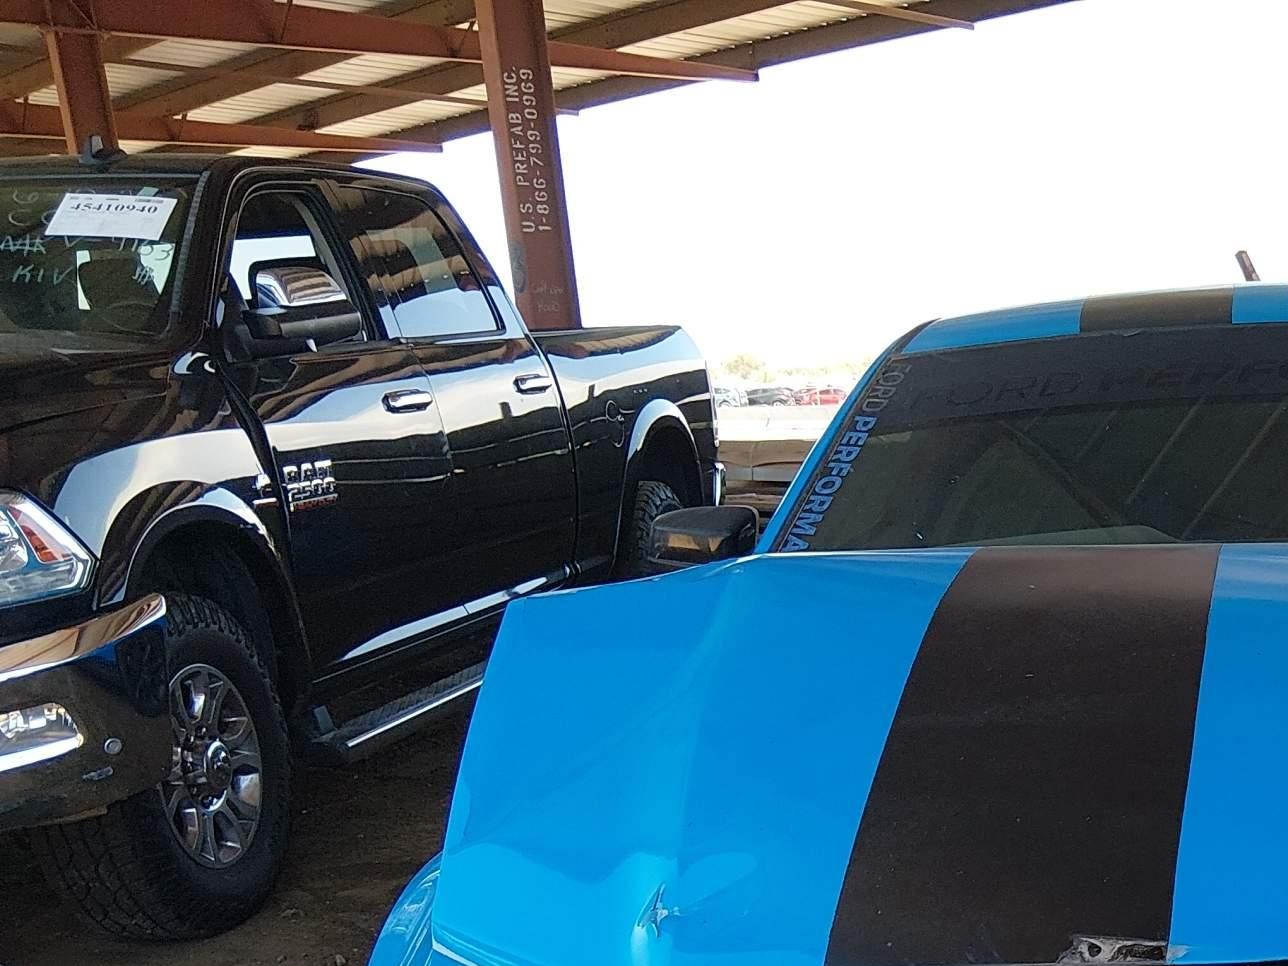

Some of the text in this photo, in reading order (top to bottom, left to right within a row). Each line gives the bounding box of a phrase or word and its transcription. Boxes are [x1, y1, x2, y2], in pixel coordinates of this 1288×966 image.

[503, 66, 520, 103] INC.
[508, 112, 531, 187] PREFAB
[519, 68, 553, 232] 1-866-799-0969
[70, 201, 159, 215] 45410940
[906, 370, 1082, 410] FORD
